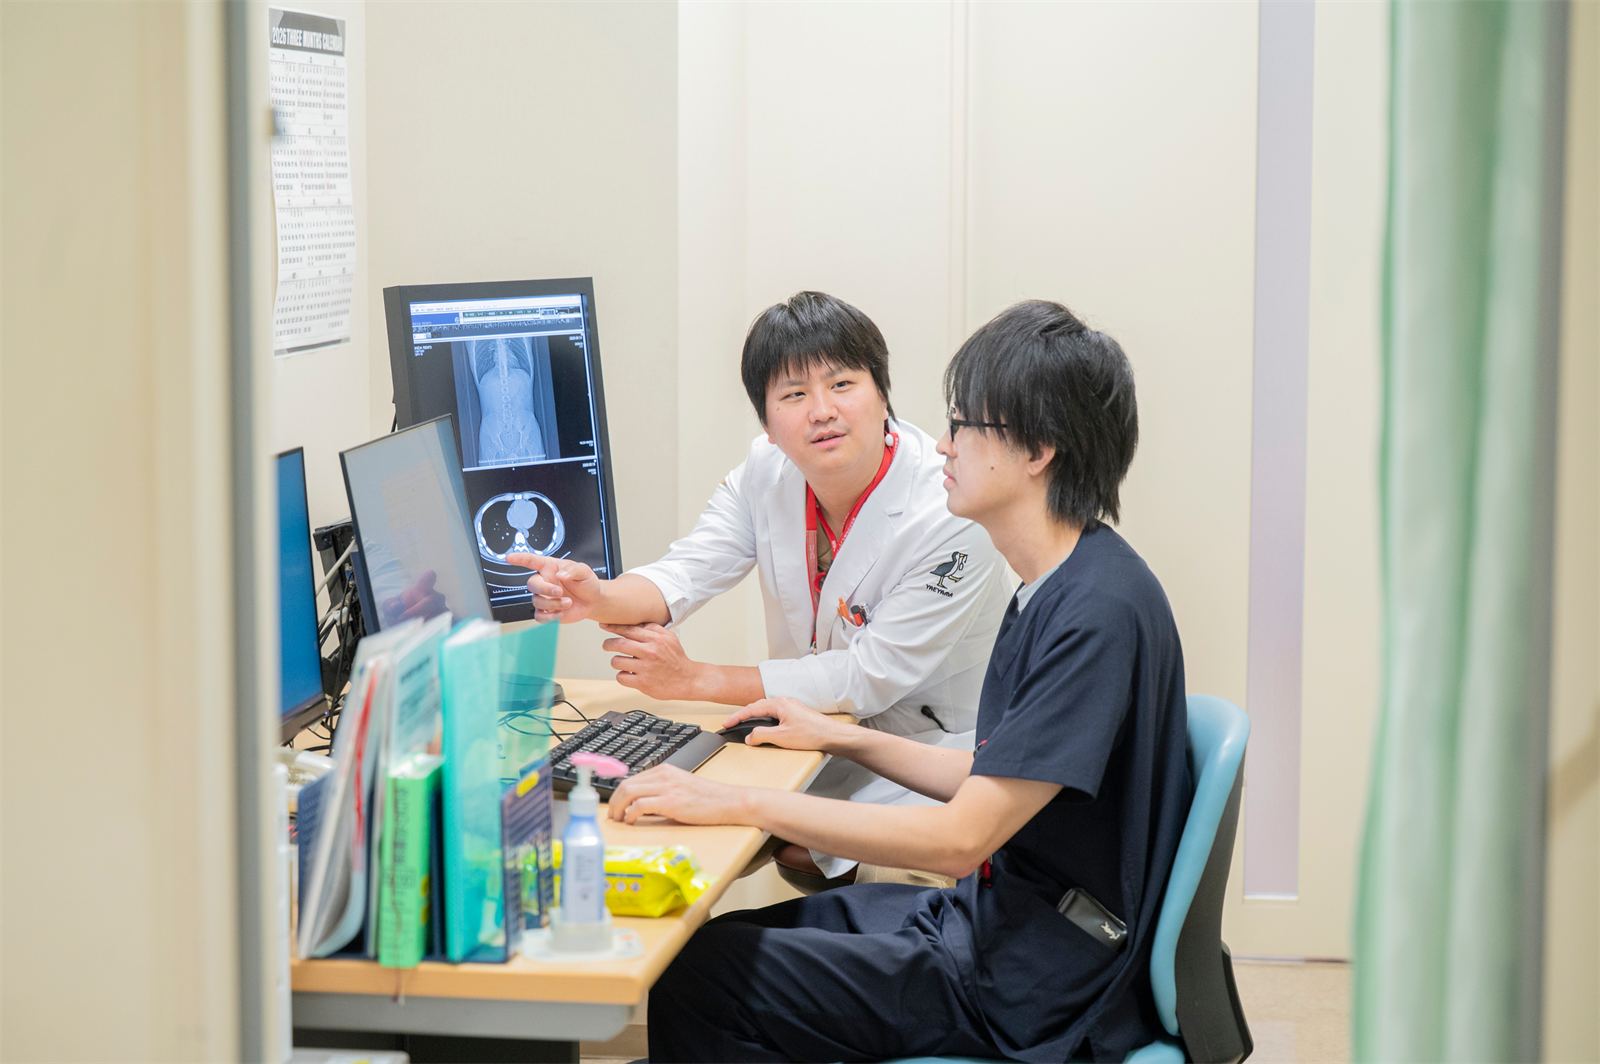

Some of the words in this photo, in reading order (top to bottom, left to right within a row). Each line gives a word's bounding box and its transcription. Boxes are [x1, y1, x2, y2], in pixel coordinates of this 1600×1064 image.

[272, 27, 286, 45] 2026
[286, 28, 302, 47] THREE
[302, 30, 322, 50] MONTHS
[926, 583, 953, 597] YAEYAMA
